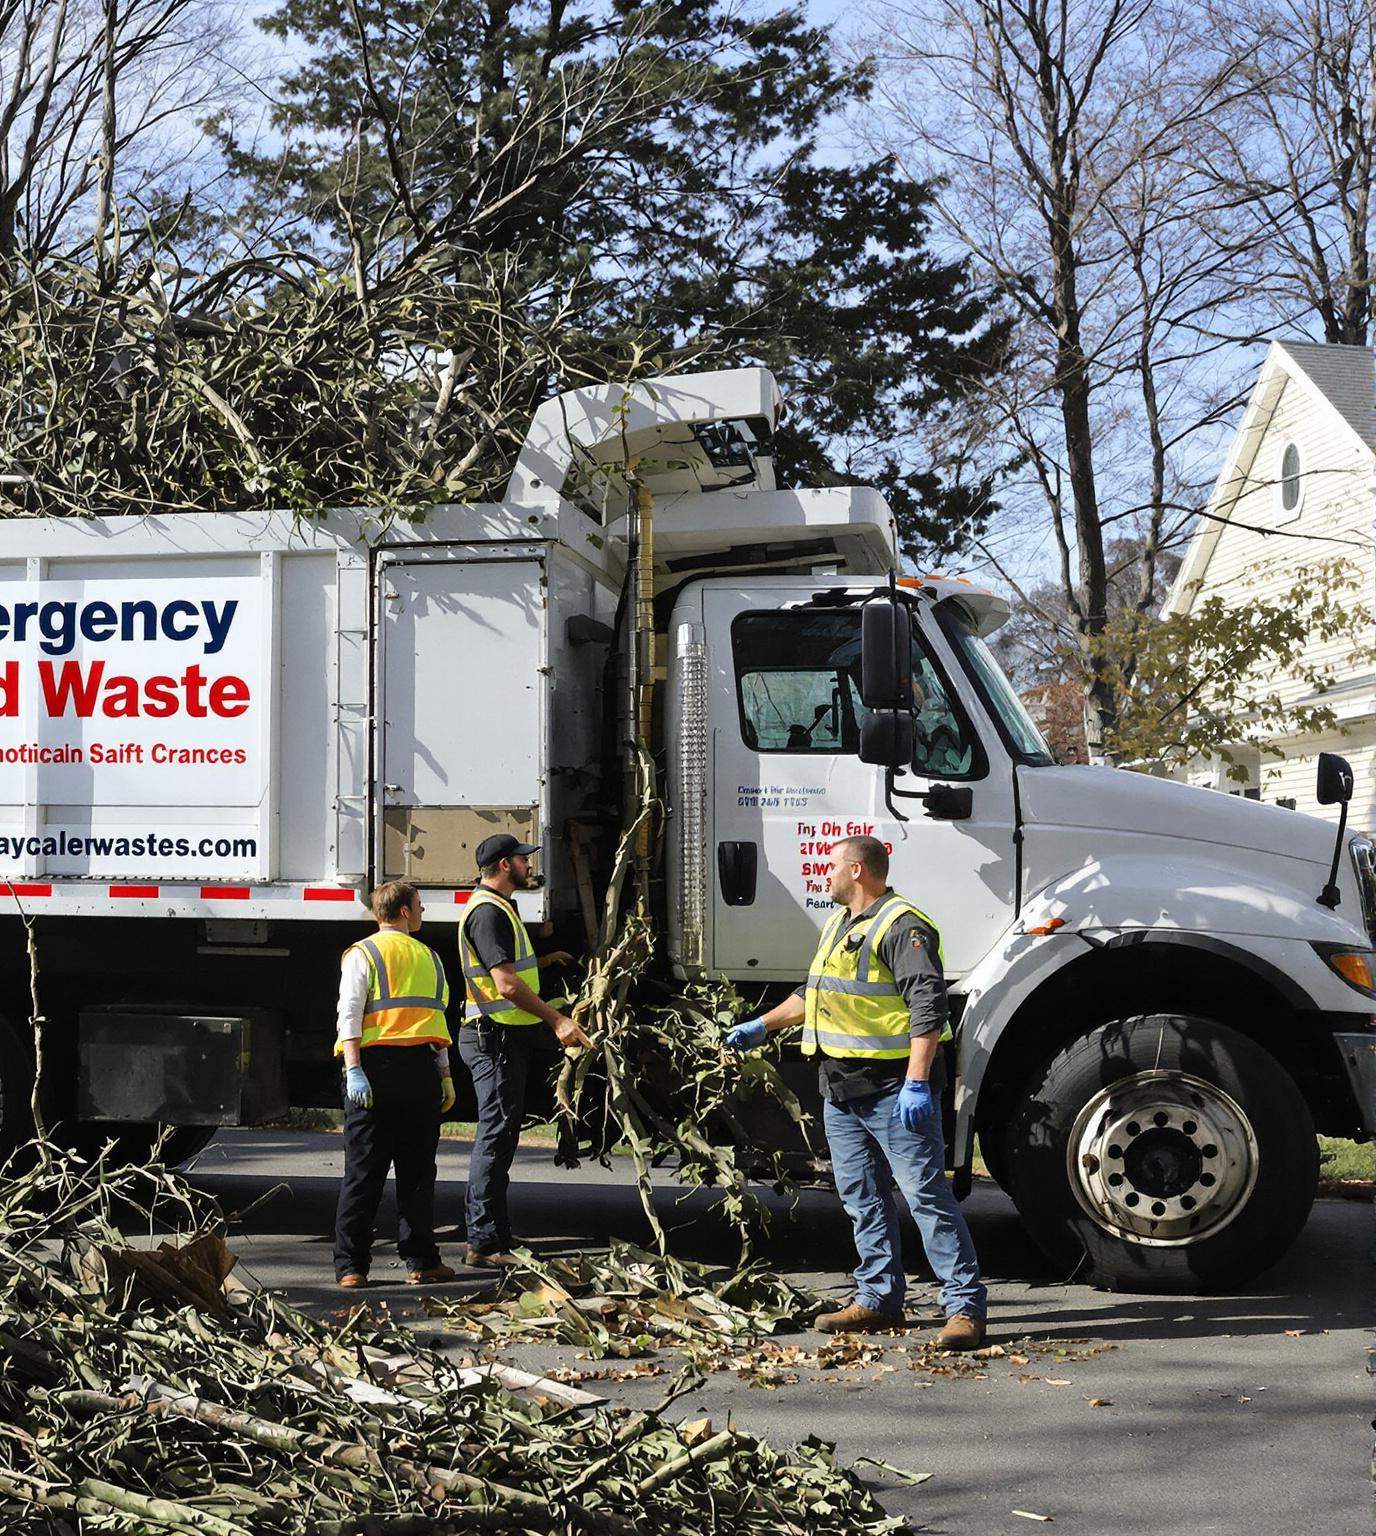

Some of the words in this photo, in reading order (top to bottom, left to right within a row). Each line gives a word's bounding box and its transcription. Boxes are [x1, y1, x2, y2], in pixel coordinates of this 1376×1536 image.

[37, 659, 251, 719] Waste
[88, 742, 143, 765] Saift
[150, 742, 247, 765] Crances
